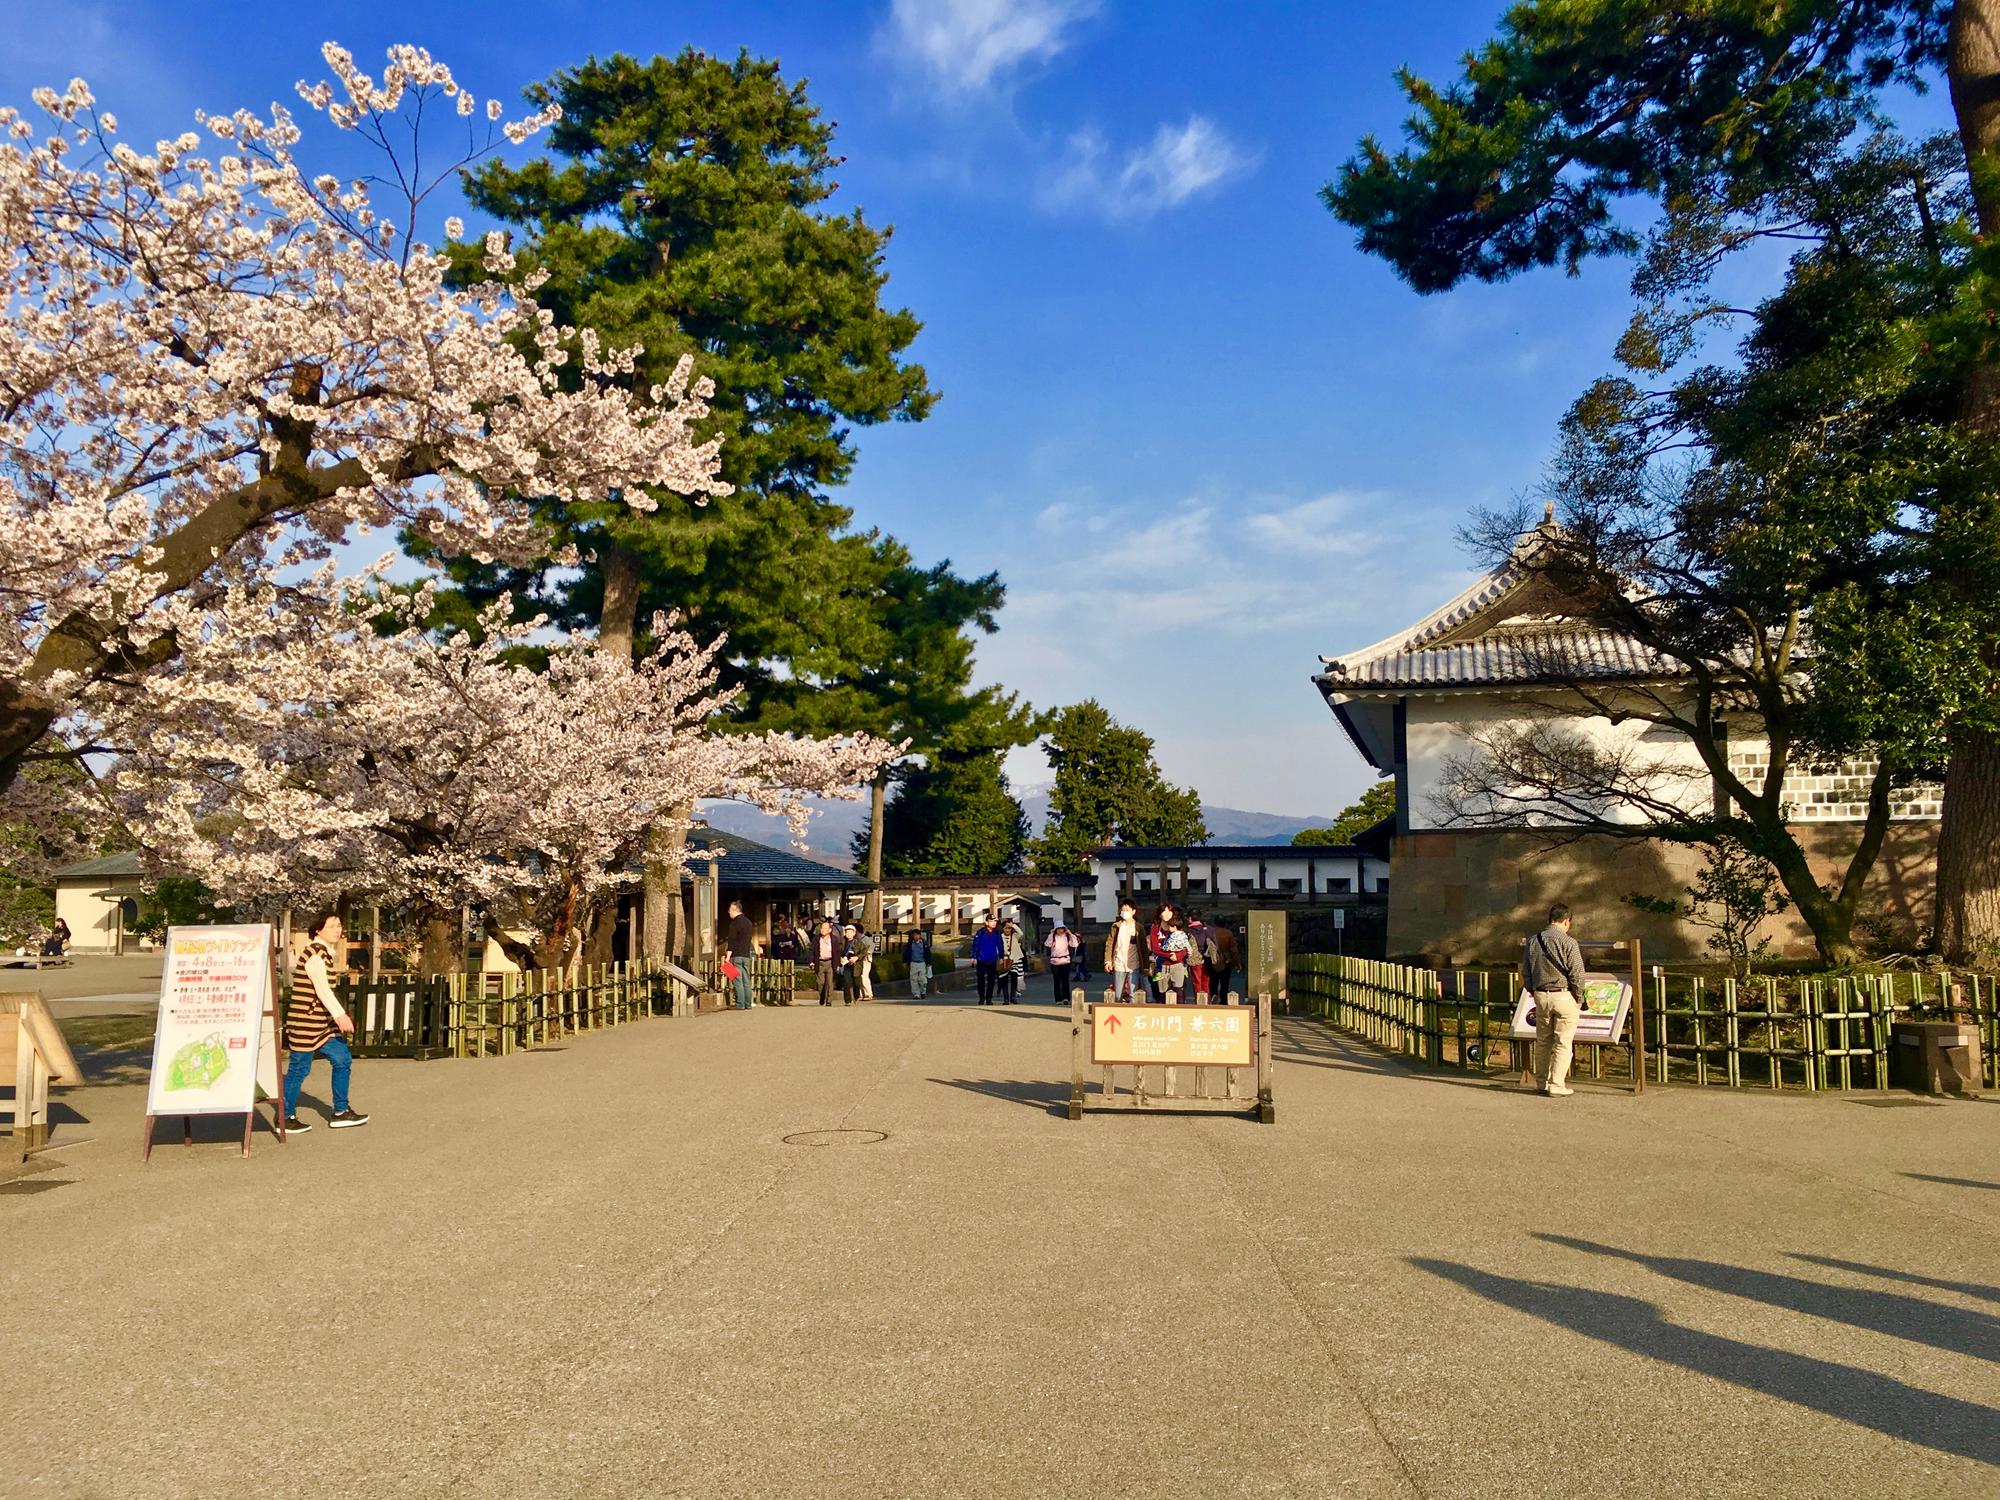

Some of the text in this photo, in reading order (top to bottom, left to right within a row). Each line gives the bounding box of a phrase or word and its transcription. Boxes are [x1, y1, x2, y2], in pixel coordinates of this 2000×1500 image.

[1134, 1015, 1239, 1032] 石川門 兼六園
